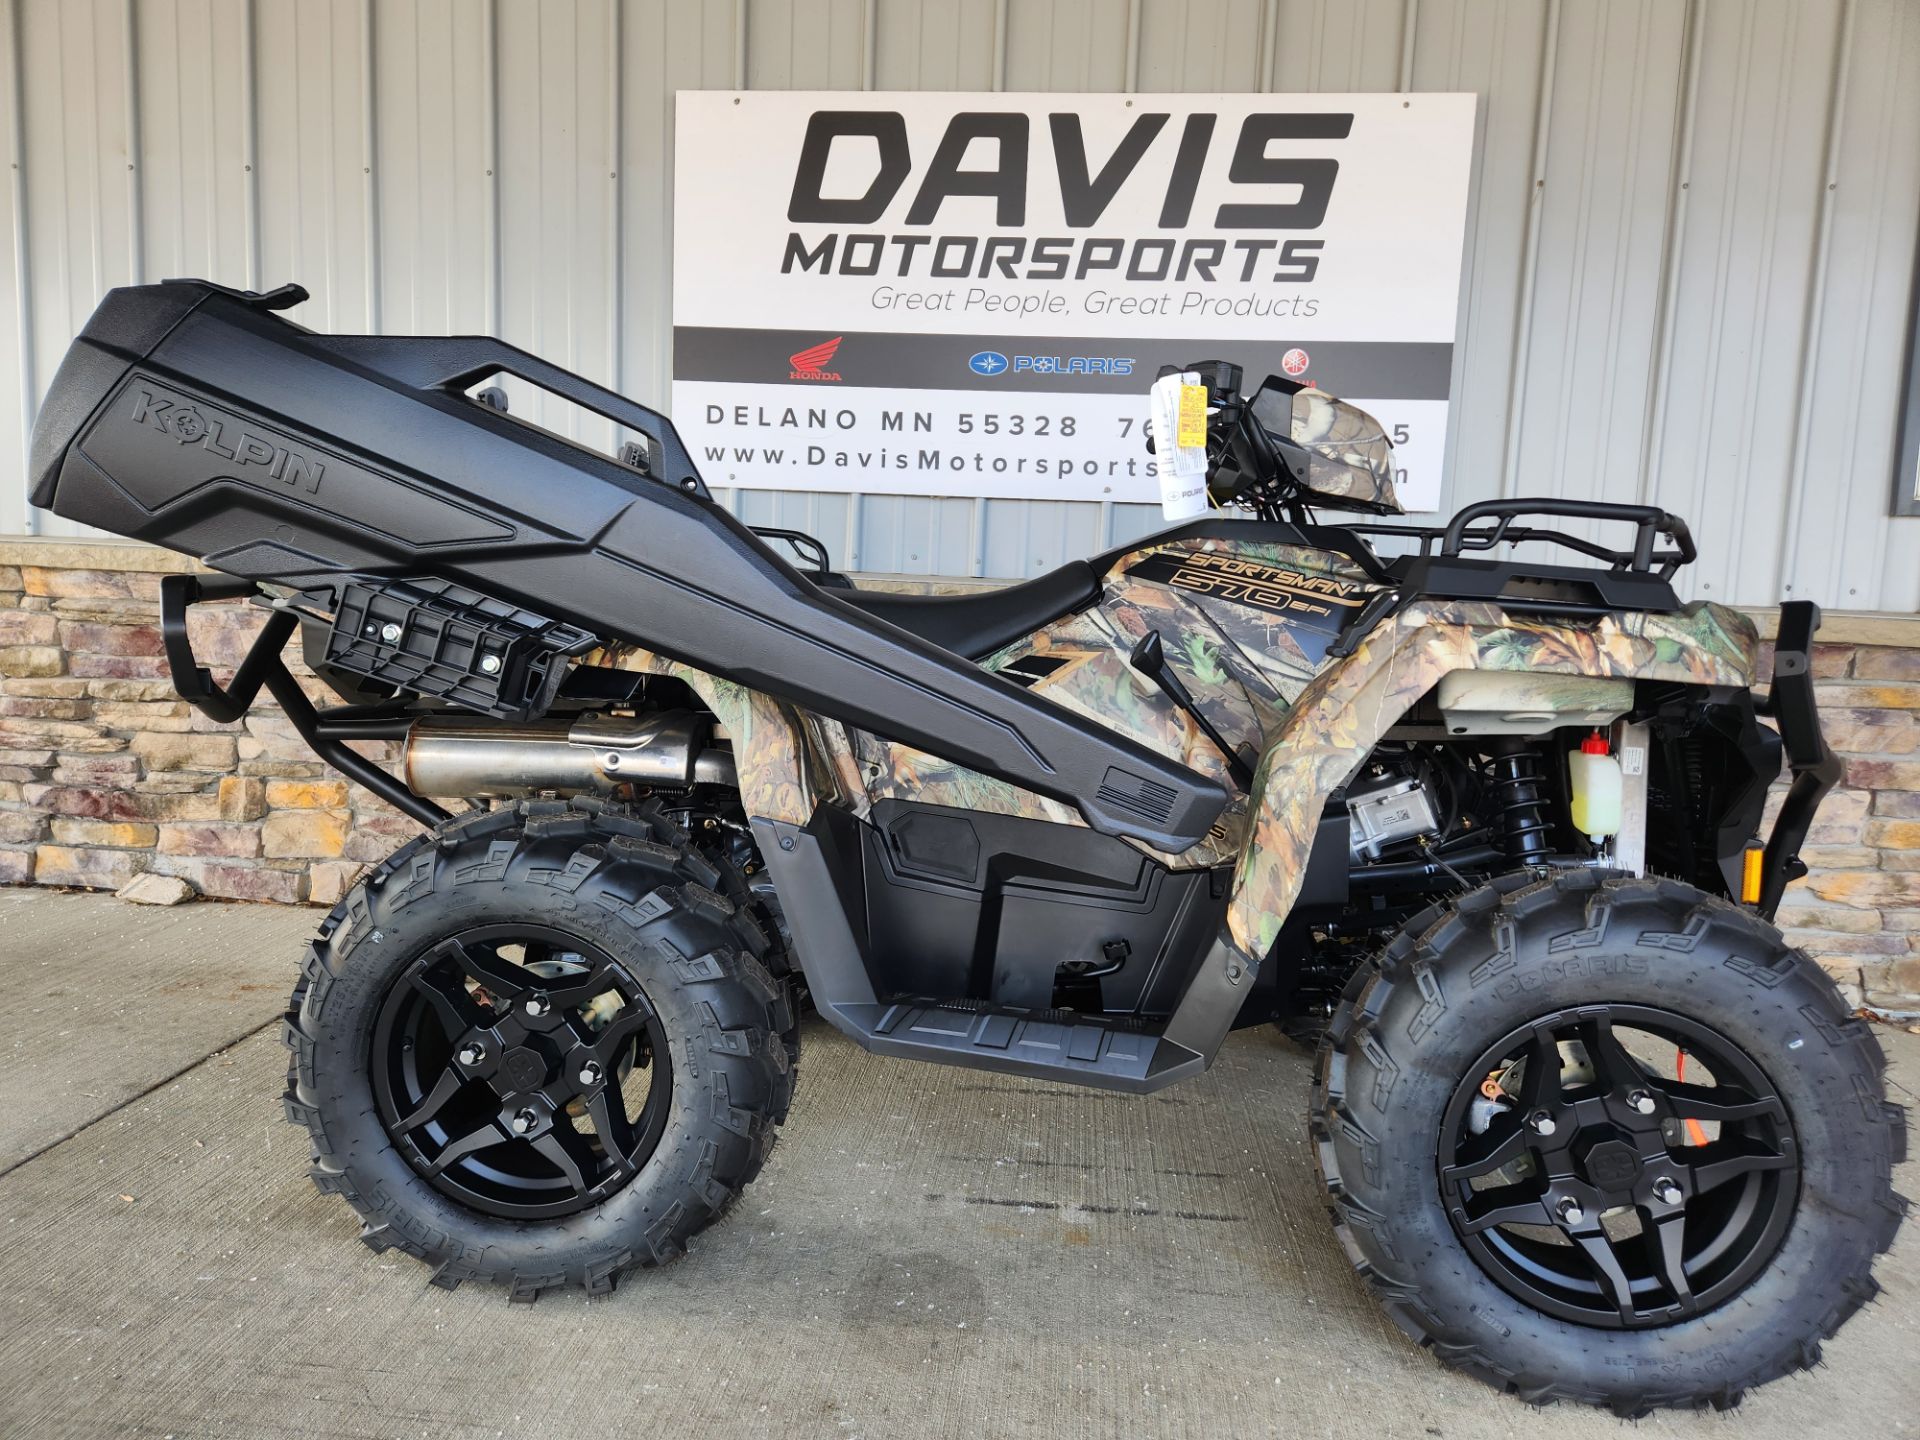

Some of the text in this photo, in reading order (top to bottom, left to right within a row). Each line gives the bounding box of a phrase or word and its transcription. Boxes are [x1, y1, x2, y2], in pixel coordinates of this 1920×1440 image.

[787, 111, 1354, 230] DAVIS
[781, 232, 1325, 283] MOTORSPORTS
[871, 286, 1320, 319] Great People, Great Products
[789, 371, 842, 382] HONDA
[1013, 355, 1134, 376] POLARIS
[132, 390, 326, 495] KOLPIN
[706, 404, 856, 430] DELANO
[881, 410, 932, 433] MN
[958, 413, 1076, 437] 55328
[704, 445, 1159, 479] www.DavisMotorsports
[1168, 568, 1332, 618] 570 EFI
[1185, 552, 1354, 598] SPORTSMAN
[1494, 955, 1650, 1001] POLARIS
